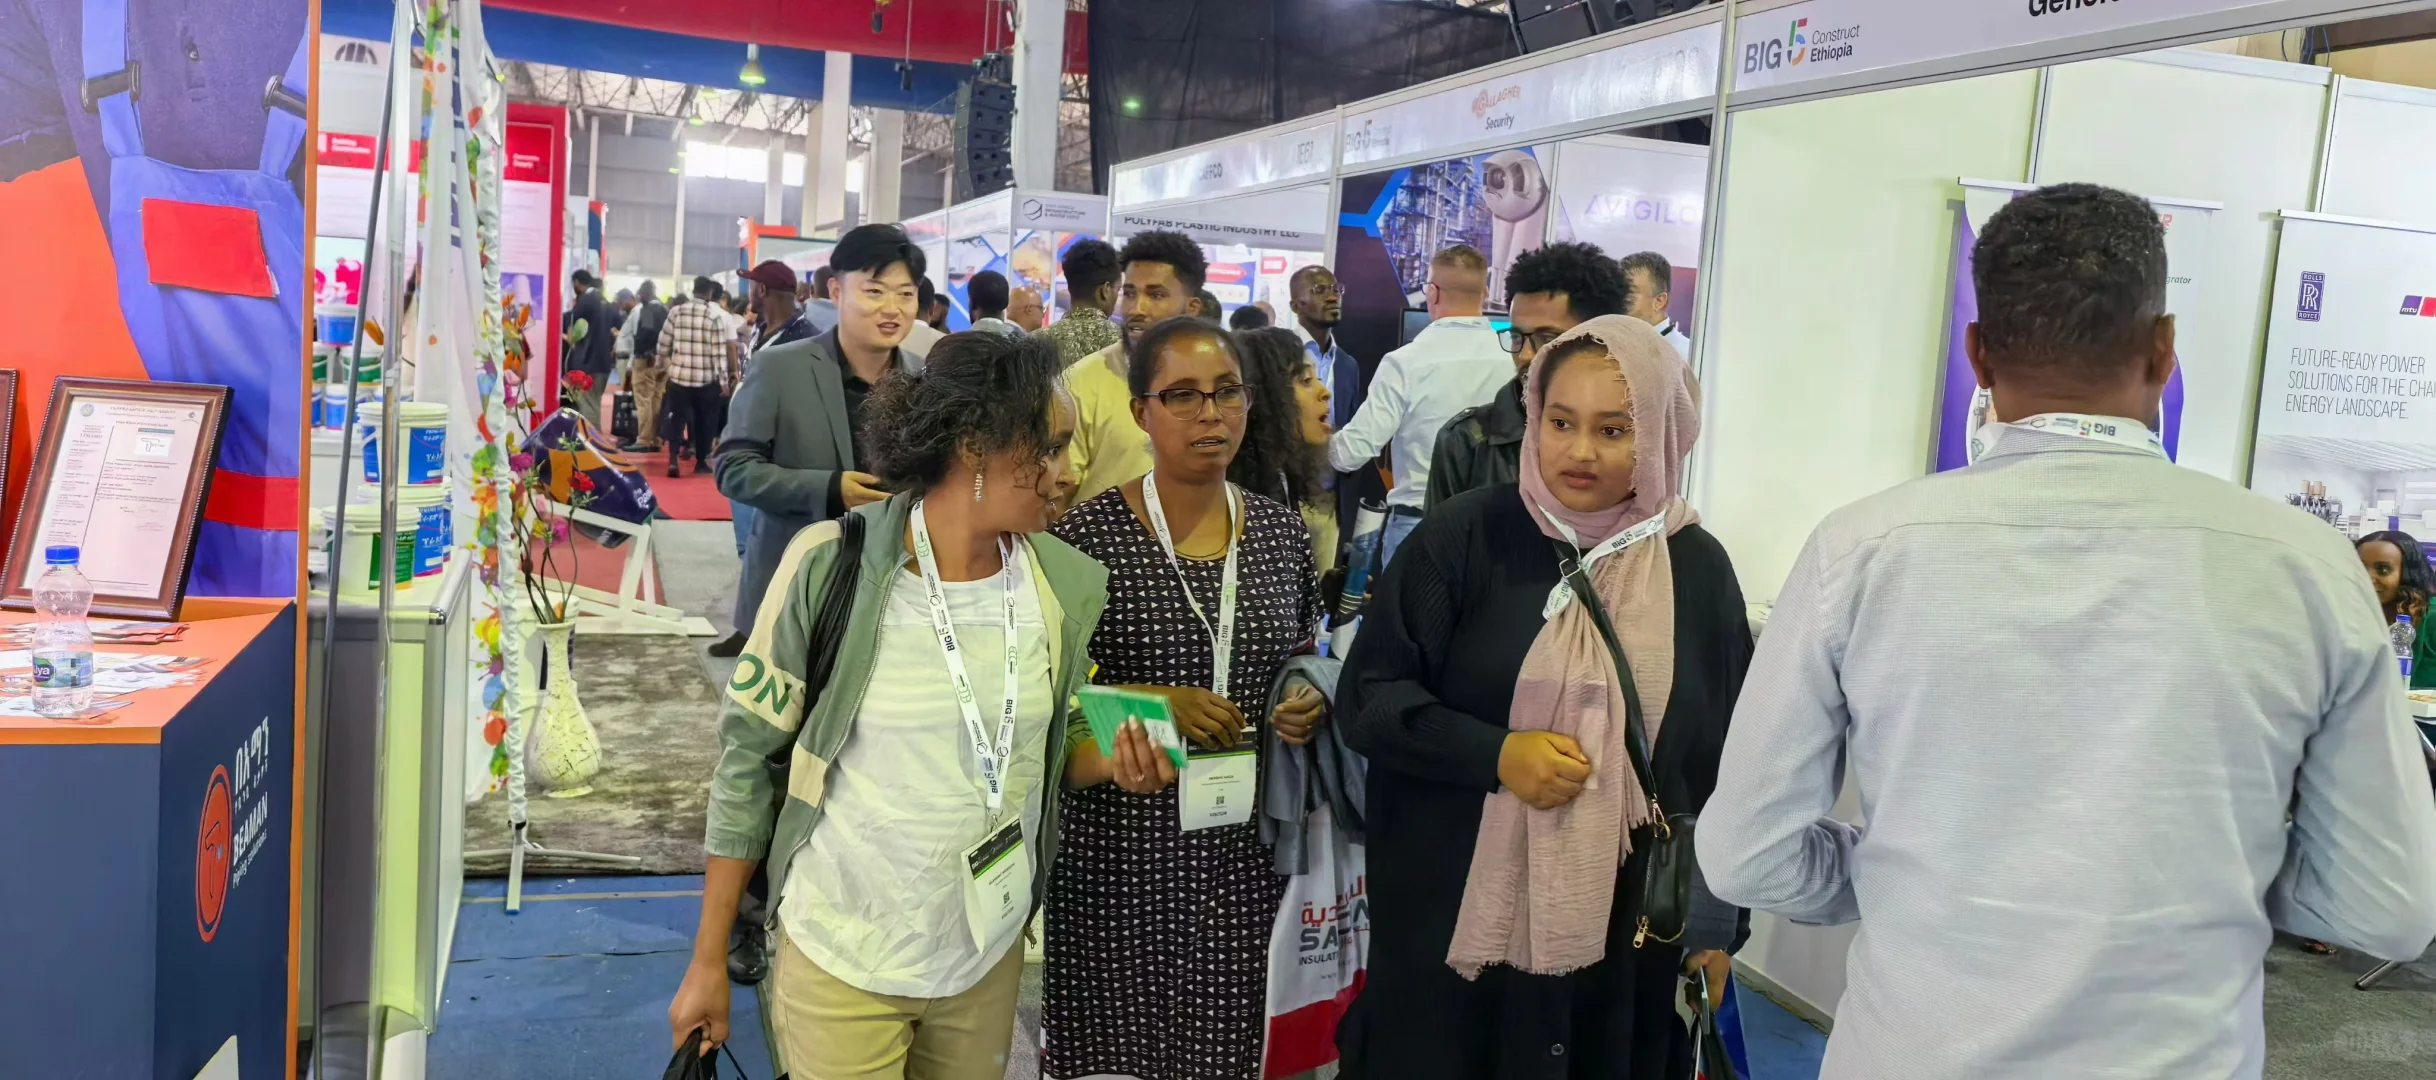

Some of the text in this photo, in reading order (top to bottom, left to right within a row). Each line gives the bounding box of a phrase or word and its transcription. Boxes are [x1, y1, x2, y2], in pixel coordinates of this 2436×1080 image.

[1743, 38, 1782, 74] BIG
[1787, 17, 1808, 66] 5
[1811, 24, 1860, 46] Construct
[1810, 43, 1853, 64] Ethiopia
[1485, 112, 1514, 130] Security
[2165, 276, 2192, 285] grator
[2299, 312, 2318, 320] ROYCE
[2291, 347, 2426, 375] FUTURE-READY POWER
[2288, 370, 2353, 393] SOLUTIONS
[2355, 375, 2379, 394] FOR
[2382, 377, 2407, 397] THE
[2285, 393, 2410, 420] ENERGY LANDSCAPE.
[2094, 423, 2116, 437] BIG
[1611, 536, 1627, 549] BIG
[1221, 624, 1229, 638] BIG
[944, 635, 955, 651] BIG
[729, 653, 793, 716] ON
[1004, 699, 1014, 715] BIG
[990, 779, 999, 794] BIG
[233, 790, 268, 867] BEAMAN
[1298, 951, 1339, 966] INSULAT
